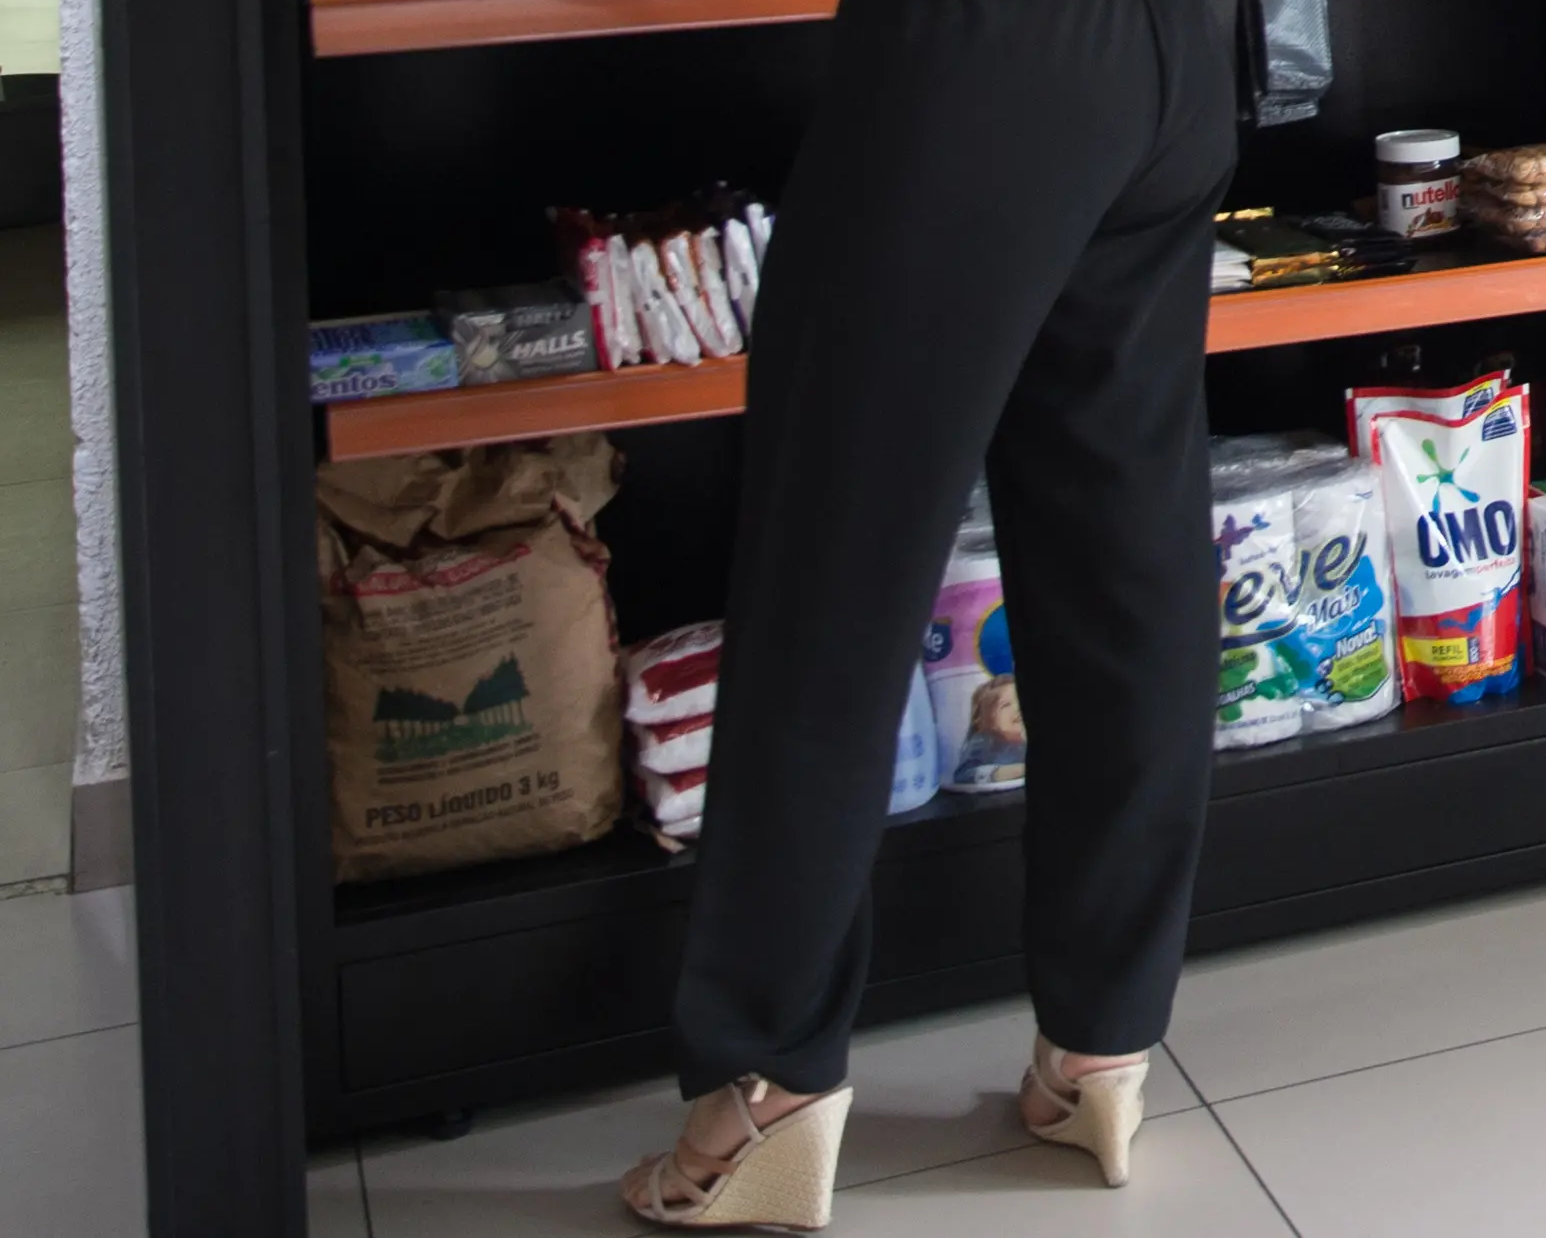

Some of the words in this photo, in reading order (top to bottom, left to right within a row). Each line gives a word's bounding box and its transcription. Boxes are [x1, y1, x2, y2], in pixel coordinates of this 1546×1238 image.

[511, 329, 588, 361] HALLS
[311, 368, 397, 398] entos
[1416, 499, 1517, 569] OMO
[1223, 531, 1368, 627] eve
[365, 803, 422, 829] PESO
[429, 783, 513, 820] LÍQUIDO
[518, 775, 531, 795] 3
[536, 770, 560, 791] kg
